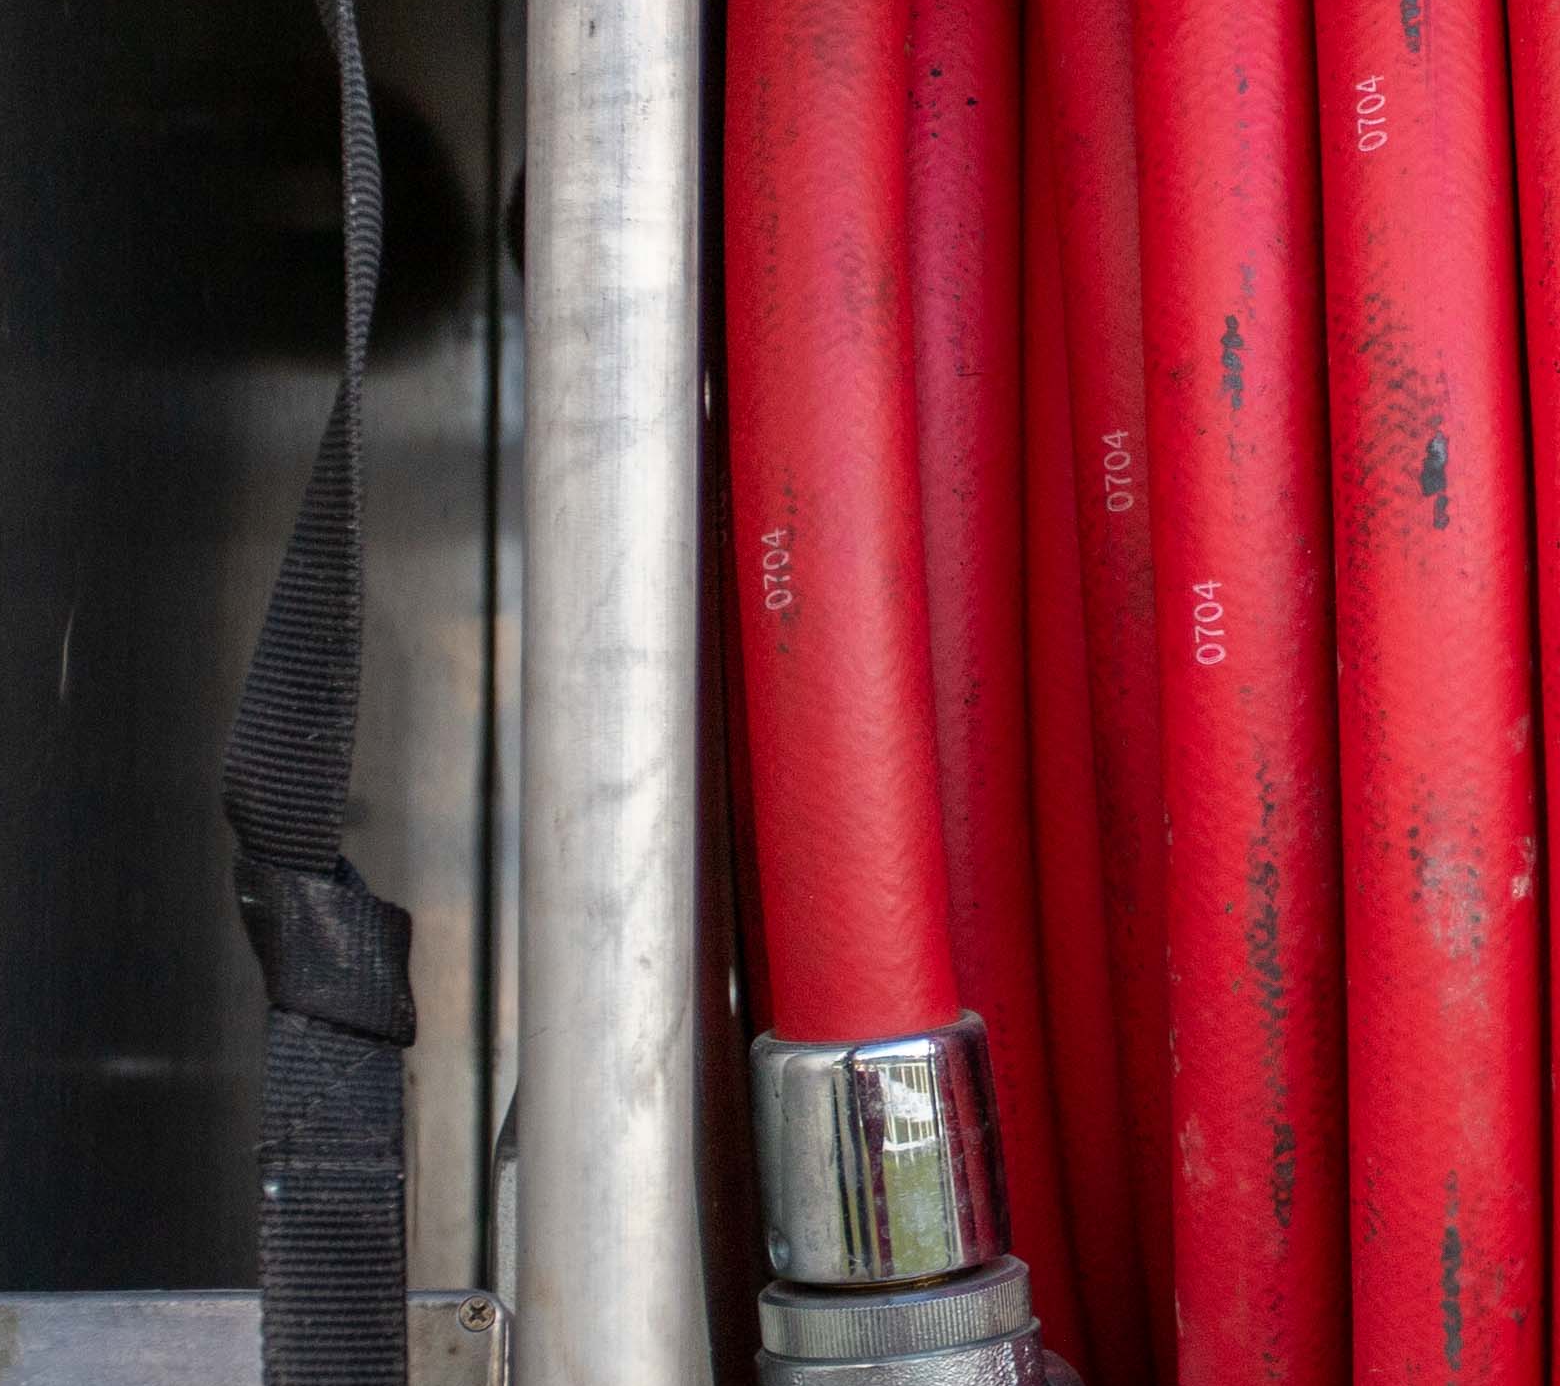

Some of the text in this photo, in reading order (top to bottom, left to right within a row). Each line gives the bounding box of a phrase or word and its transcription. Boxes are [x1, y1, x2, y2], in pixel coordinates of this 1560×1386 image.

[1356, 74, 1388, 153] 0704
[1101, 428, 1135, 513] 0704
[760, 527, 794, 612] 0704
[1192, 579, 1228, 666] 0704
